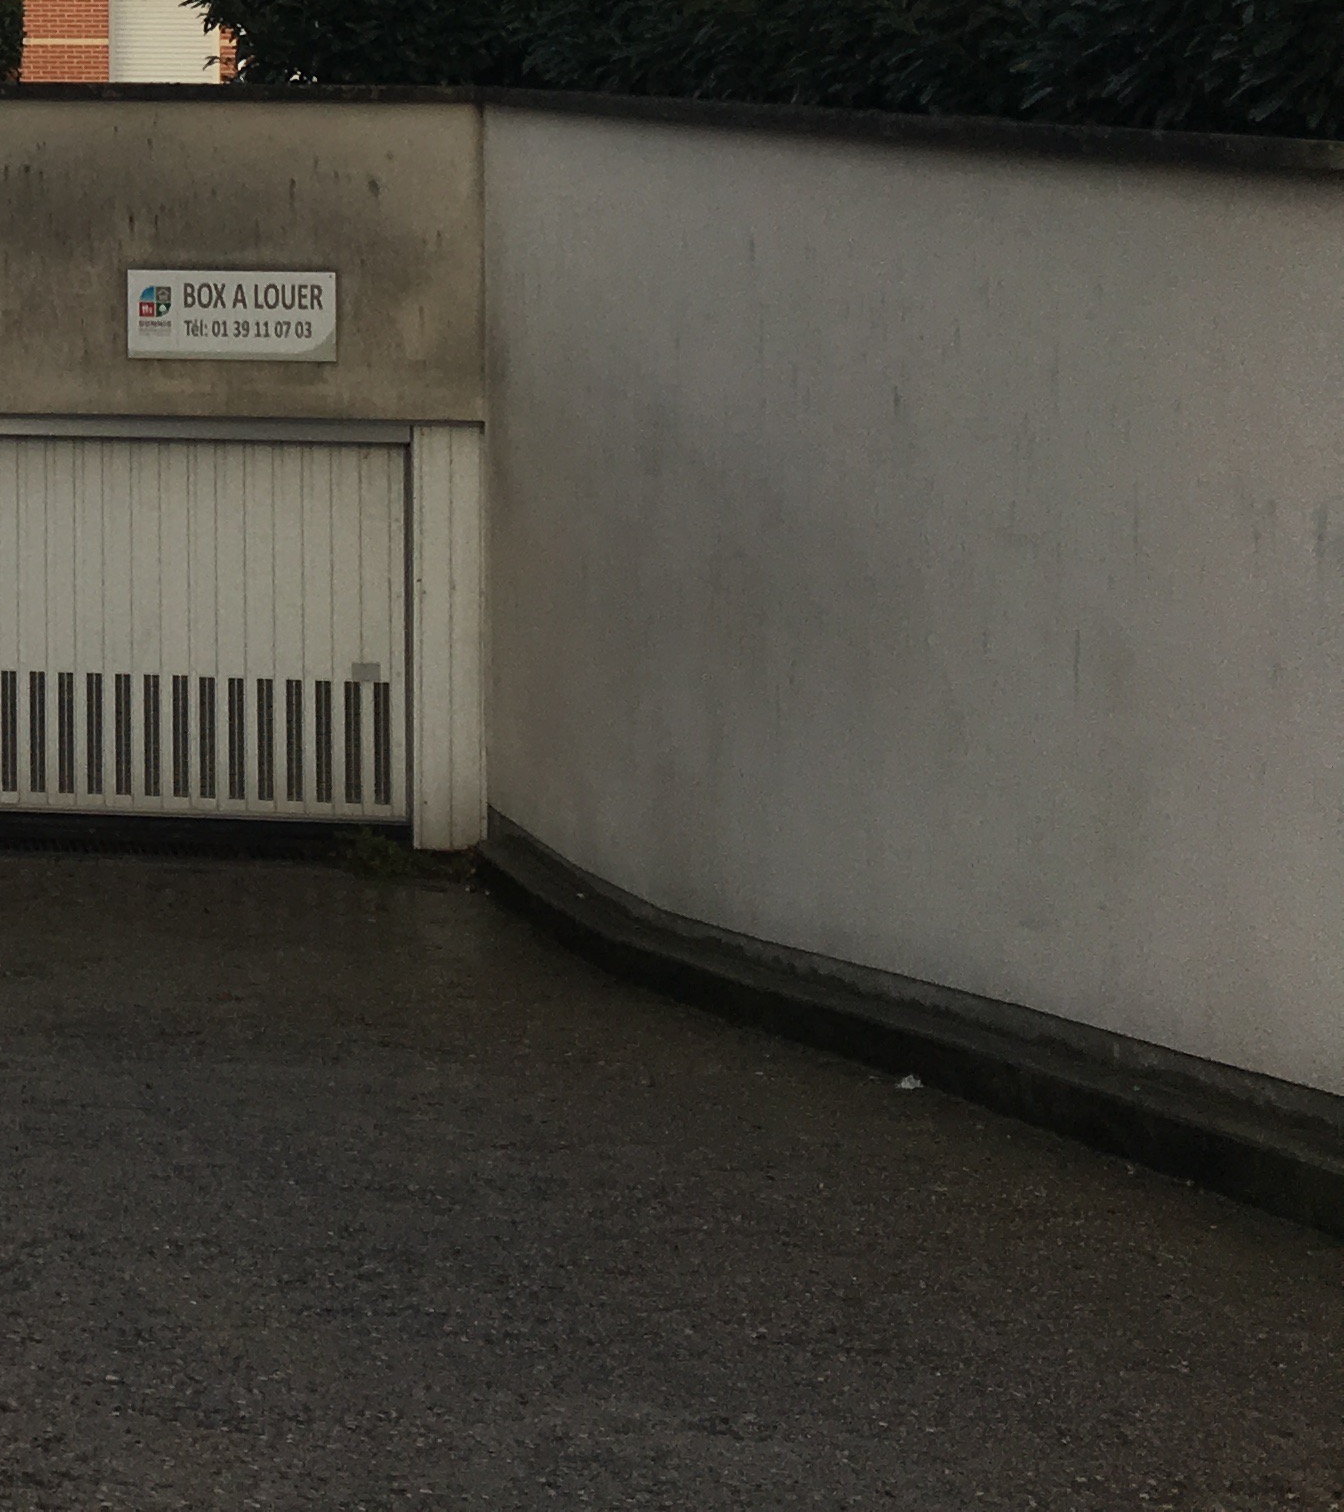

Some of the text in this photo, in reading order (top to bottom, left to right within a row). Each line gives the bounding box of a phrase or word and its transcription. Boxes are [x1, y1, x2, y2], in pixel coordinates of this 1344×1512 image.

[183, 283, 324, 311] BOX A LOUER
[184, 319, 208, 338] Tél:
[212, 320, 229, 338] 01
[233, 321, 250, 338] 39
[255, 321, 270, 338] 11
[274, 321, 292, 339] 07
[295, 321, 312, 339] 03
